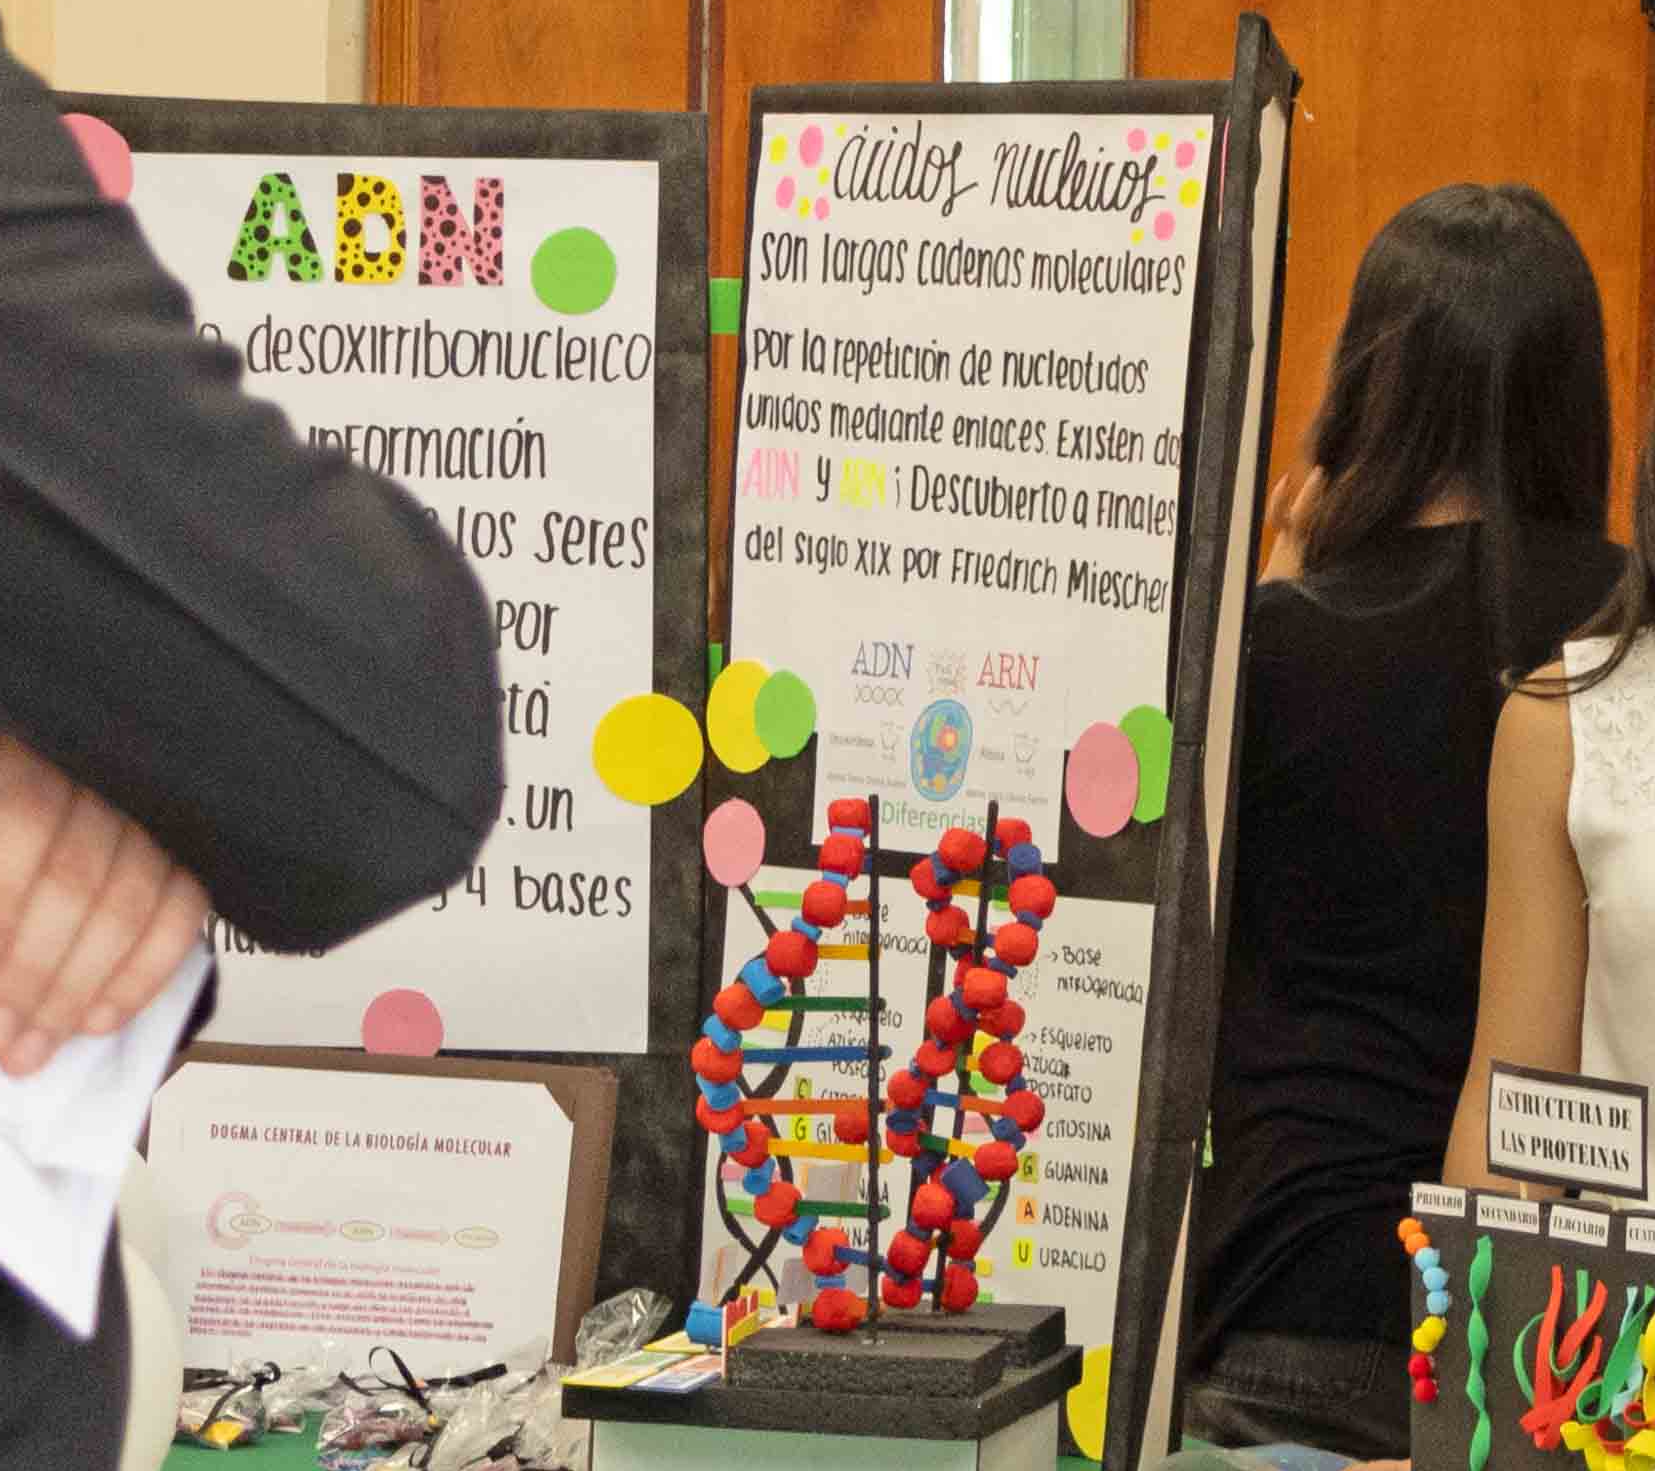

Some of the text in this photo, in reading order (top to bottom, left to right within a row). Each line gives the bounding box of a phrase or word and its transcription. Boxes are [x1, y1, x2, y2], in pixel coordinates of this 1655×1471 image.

[833, 120, 1165, 222] ácidos nucleicos
[227, 172, 505, 285] ADN
[760, 231, 1185, 296] son largas cadenas moleculares
[247, 314, 652, 383] desoxirribonucleico
[801, 327, 827, 375] la
[832, 338, 951, 388] repetición
[959, 343, 992, 387] de
[829, 401, 944, 445] mediante
[952, 414, 1049, 456] enlaces.
[1056, 419, 1144, 465] Existen
[741, 446, 801, 499] ADN
[816, 454, 832, 503] y
[910, 463, 1067, 525] Descubierto
[1072, 488, 1088, 529] a
[455, 505, 649, 569] los seres
[744, 524, 784, 564] del
[794, 529, 848, 575] siglo
[854, 535, 891, 577] XIX
[951, 547, 1058, 597] Friedrich
[1066, 558, 1169, 615] Miescher
[850, 638, 915, 680] ADN
[976, 649, 1041, 691] ARN
[524, 783, 575, 832] un
[881, 800, 988, 832] Diferencias
[465, 865, 488, 907] 4
[512, 864, 633, 918] bases
[1061, 944, 1102, 967] Base
[797, 1078, 809, 1099] C
[1498, 1087, 1632, 1130] ESTRUCTURA DE
[210, 1123, 512, 1158] DOGMA CENTRAL DE LA BIOLOGÍA MOLECULAR
[794, 1117, 807, 1141] G
[1045, 1119, 1112, 1142] CITOSINA
[1023, 1156, 1110, 1186] G GUANINA
[1500, 1129, 1630, 1173] LAS PROTEINAS
[1023, 1200, 1110, 1232] A ADENINA
[1416, 1190, 1463, 1210] PRIMARIO
[1479, 1203, 1539, 1227] SECUNDARIO
[1551, 1213, 1606, 1239] TERCIARIO
[1017, 1241, 1107, 1273] U URACILO
